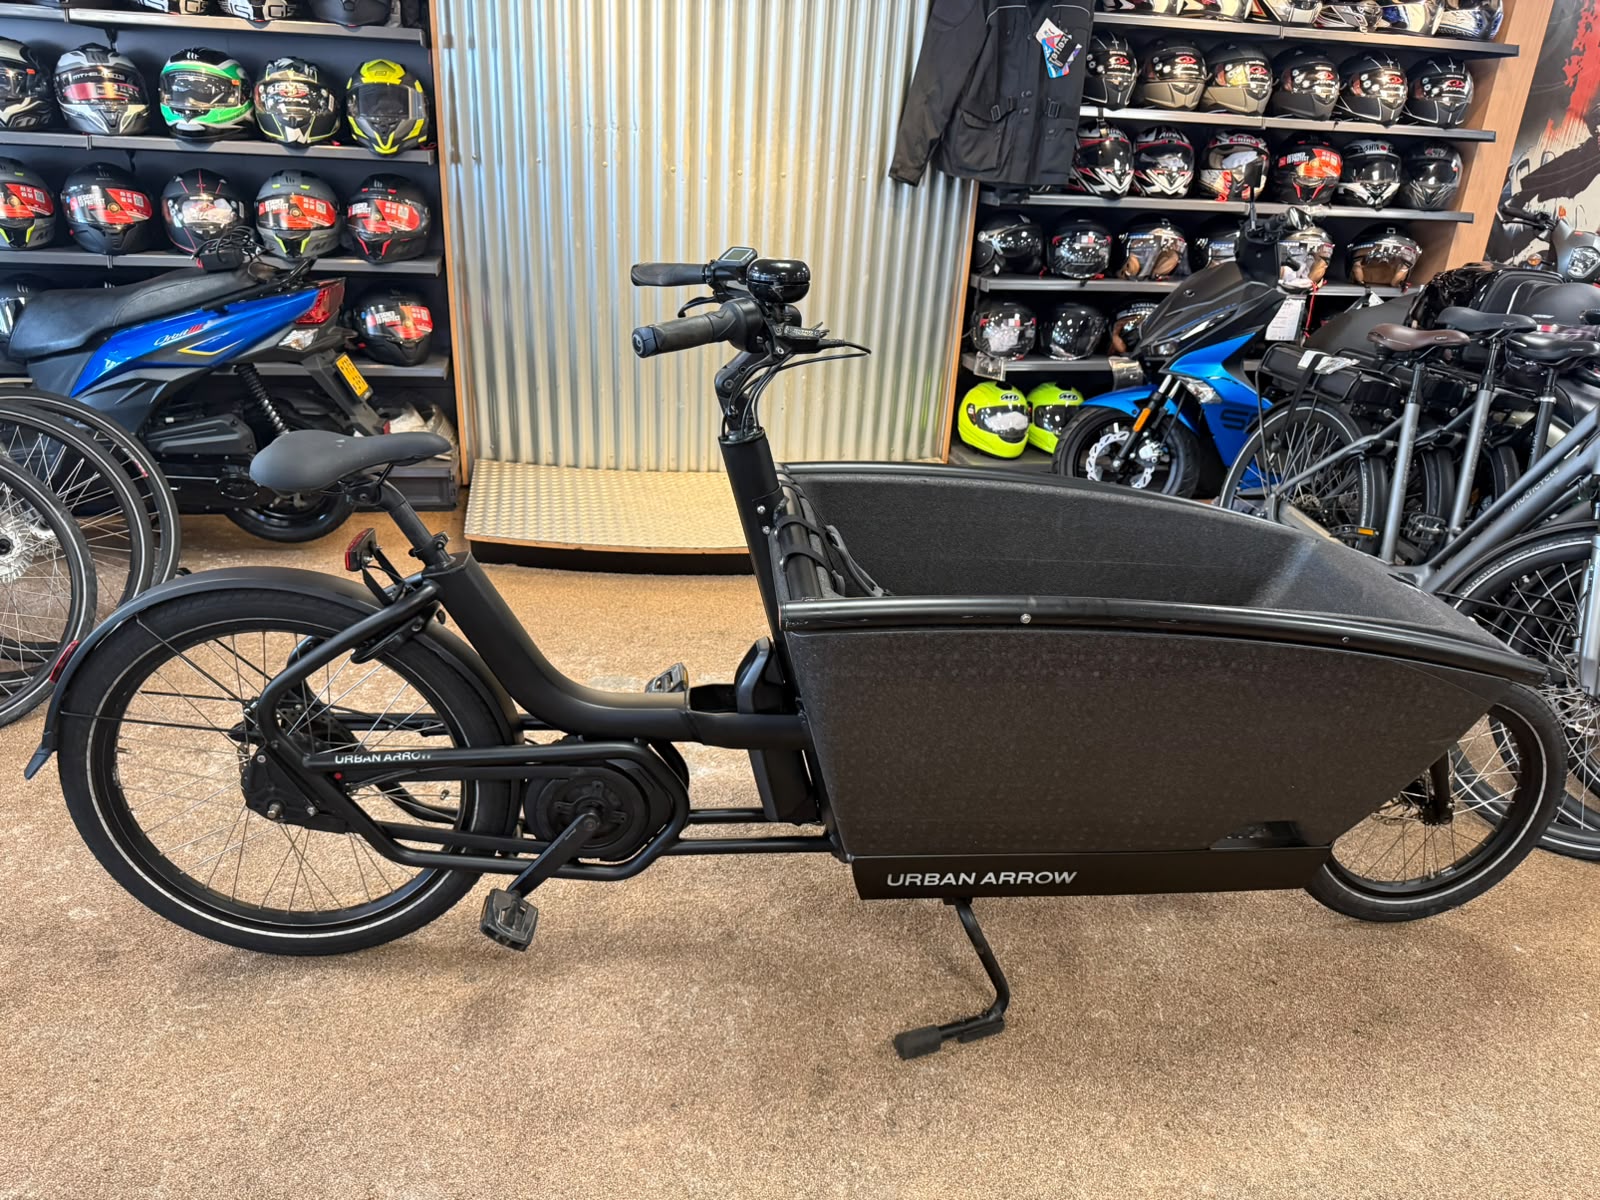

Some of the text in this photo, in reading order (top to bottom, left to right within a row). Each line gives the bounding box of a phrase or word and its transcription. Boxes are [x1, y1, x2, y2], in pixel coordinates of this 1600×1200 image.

[153, 329, 189, 346] Orbit
[335, 754, 381, 765] URBAN
[887, 871, 1077, 887] URBAN ARROW
